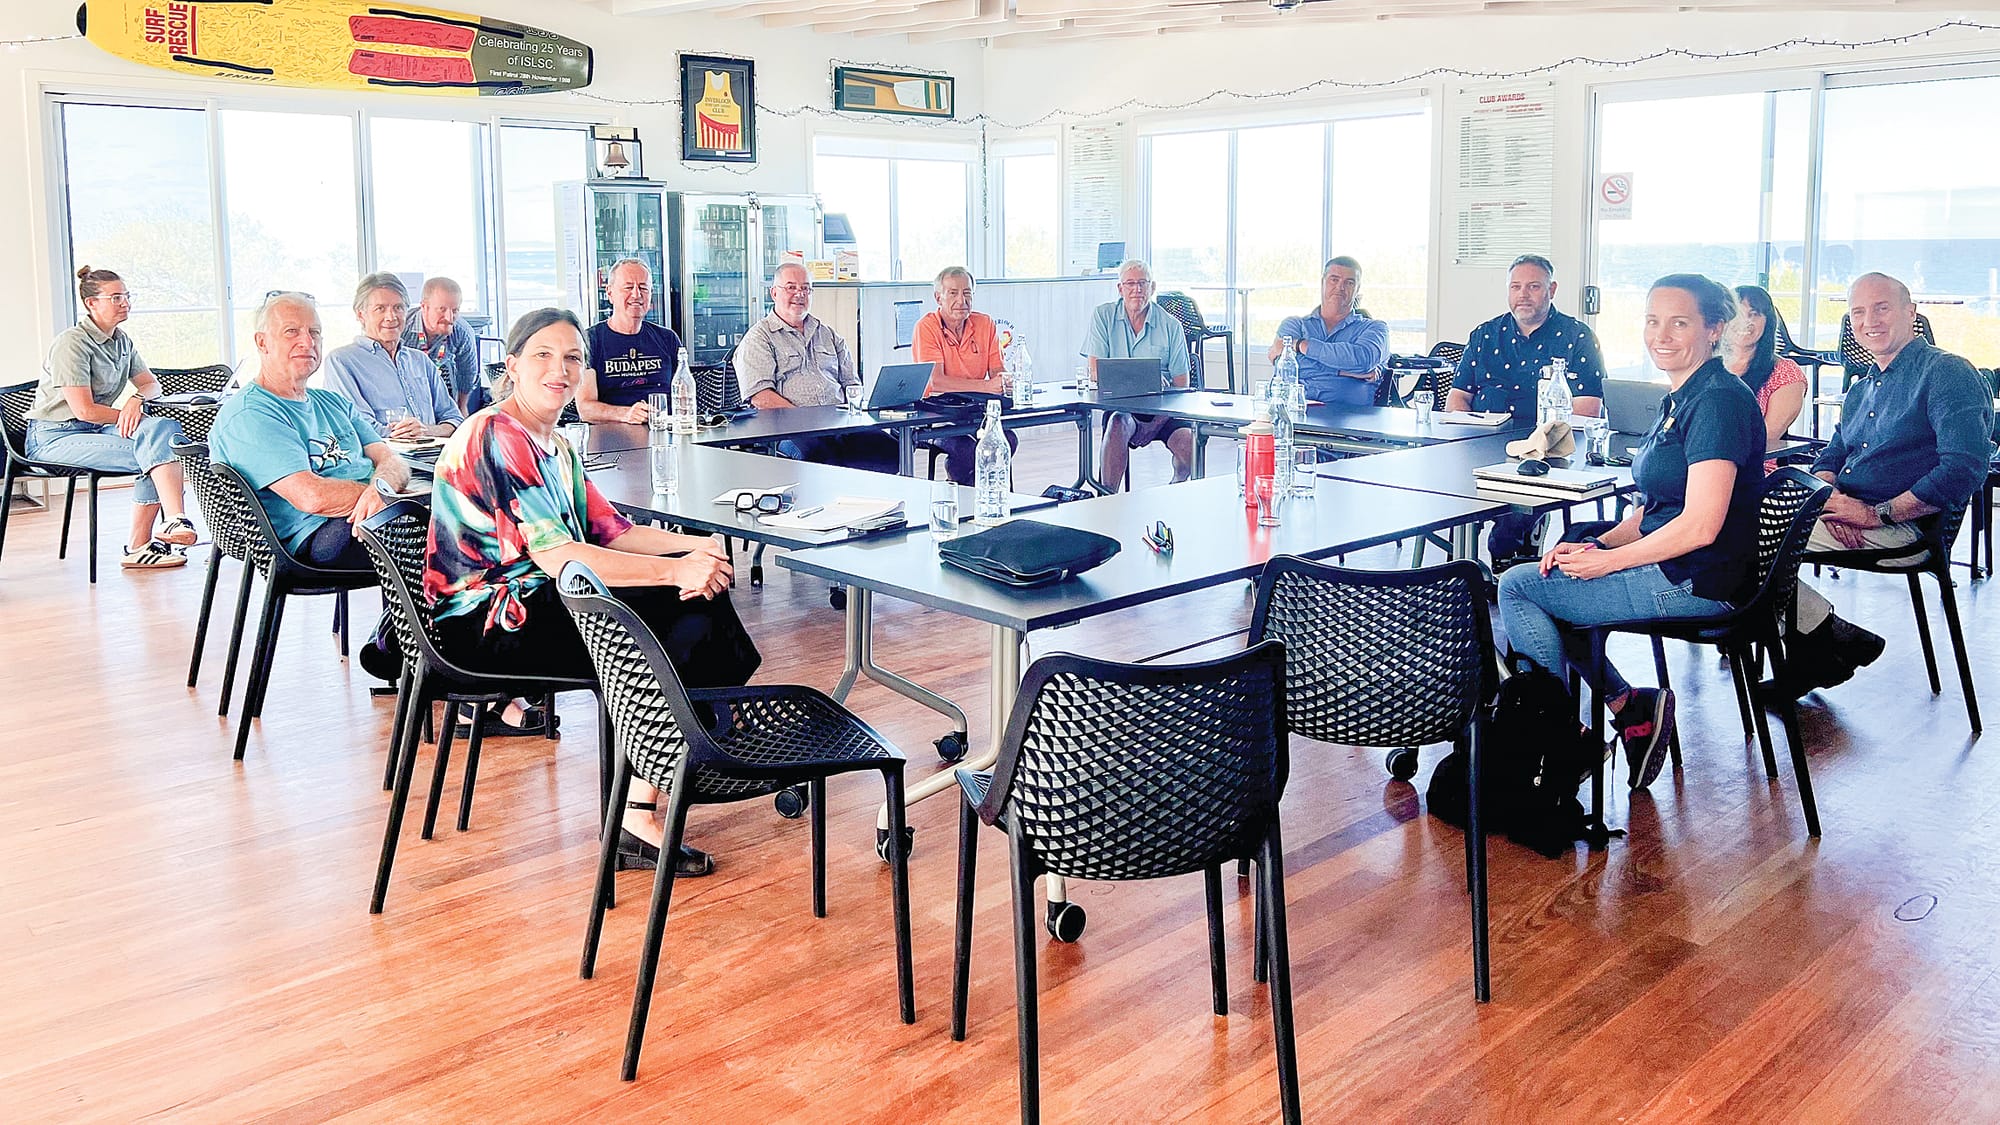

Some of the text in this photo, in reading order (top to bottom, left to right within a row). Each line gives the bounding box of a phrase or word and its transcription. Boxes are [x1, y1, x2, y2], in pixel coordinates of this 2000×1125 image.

[145, 8, 166, 43] SURF
[168, 2, 188, 54] RESCUE
[478, 35, 583, 57] Celebrating 25 Years
[507, 56, 556, 70] of ISLSC.
[531, 73, 558, 82] November
[1496, 92, 1526, 103] AWARDS
[604, 358, 663, 374] BUDAPEST
